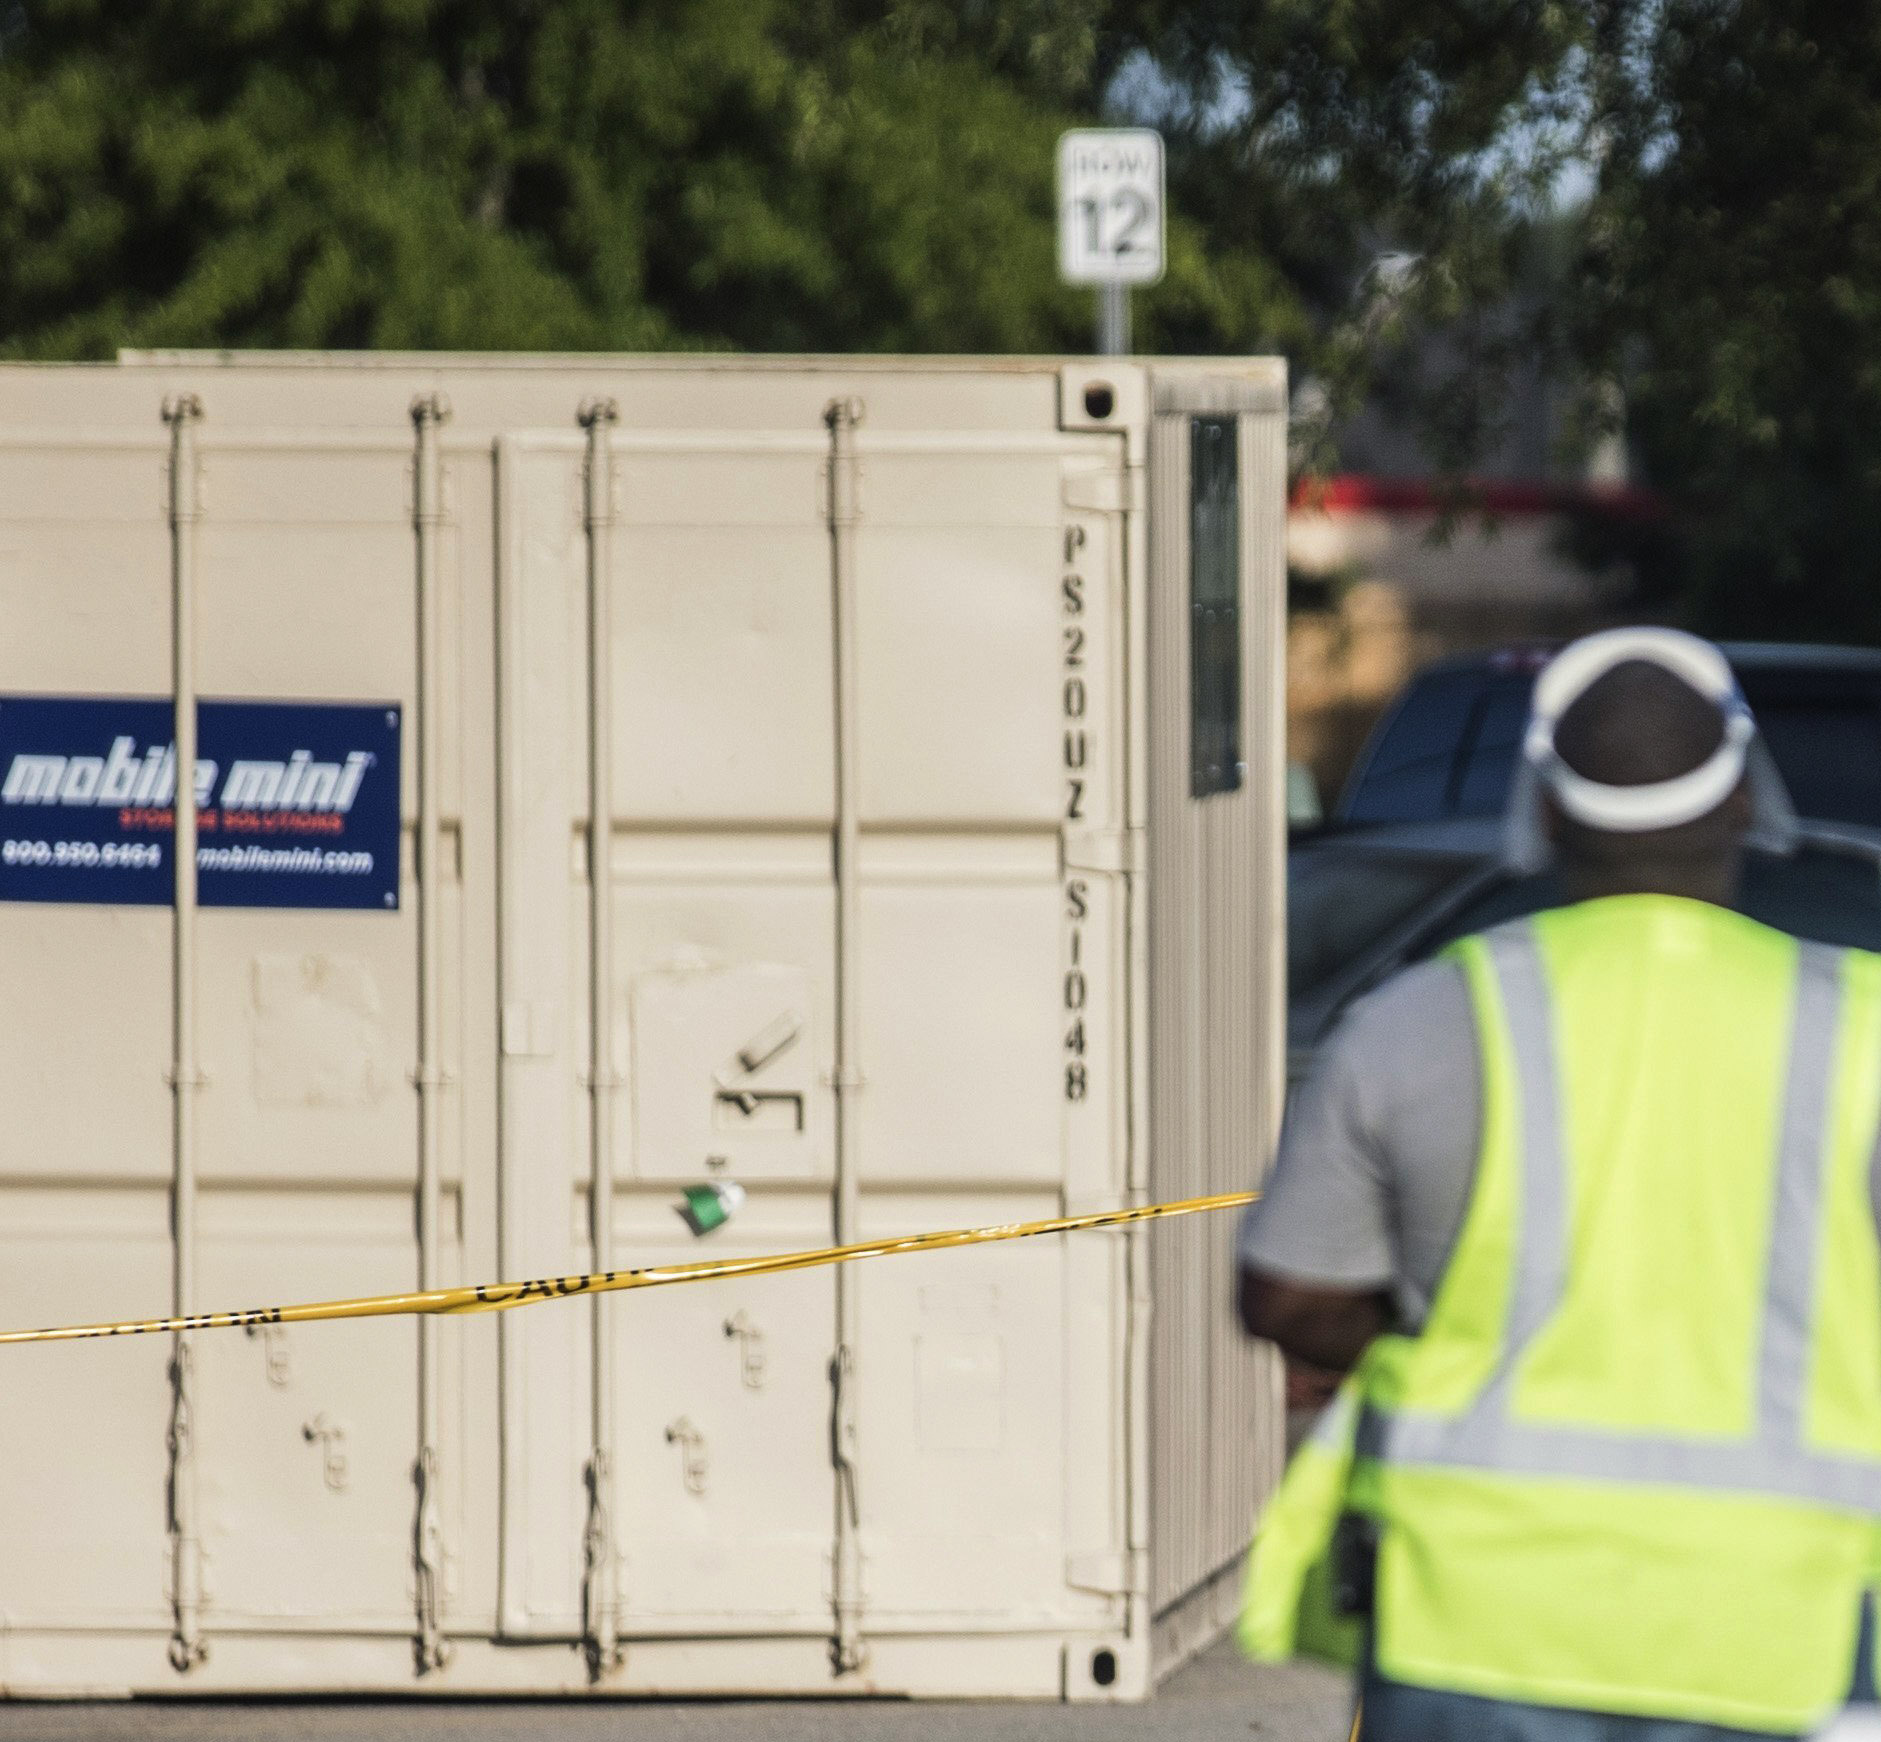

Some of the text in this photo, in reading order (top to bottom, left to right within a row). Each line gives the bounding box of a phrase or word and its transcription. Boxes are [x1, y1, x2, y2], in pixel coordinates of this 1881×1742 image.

[1079, 187, 1155, 257] 12
[219, 749, 366, 814] mini
[196, 845, 374, 875] mobilemini.com
